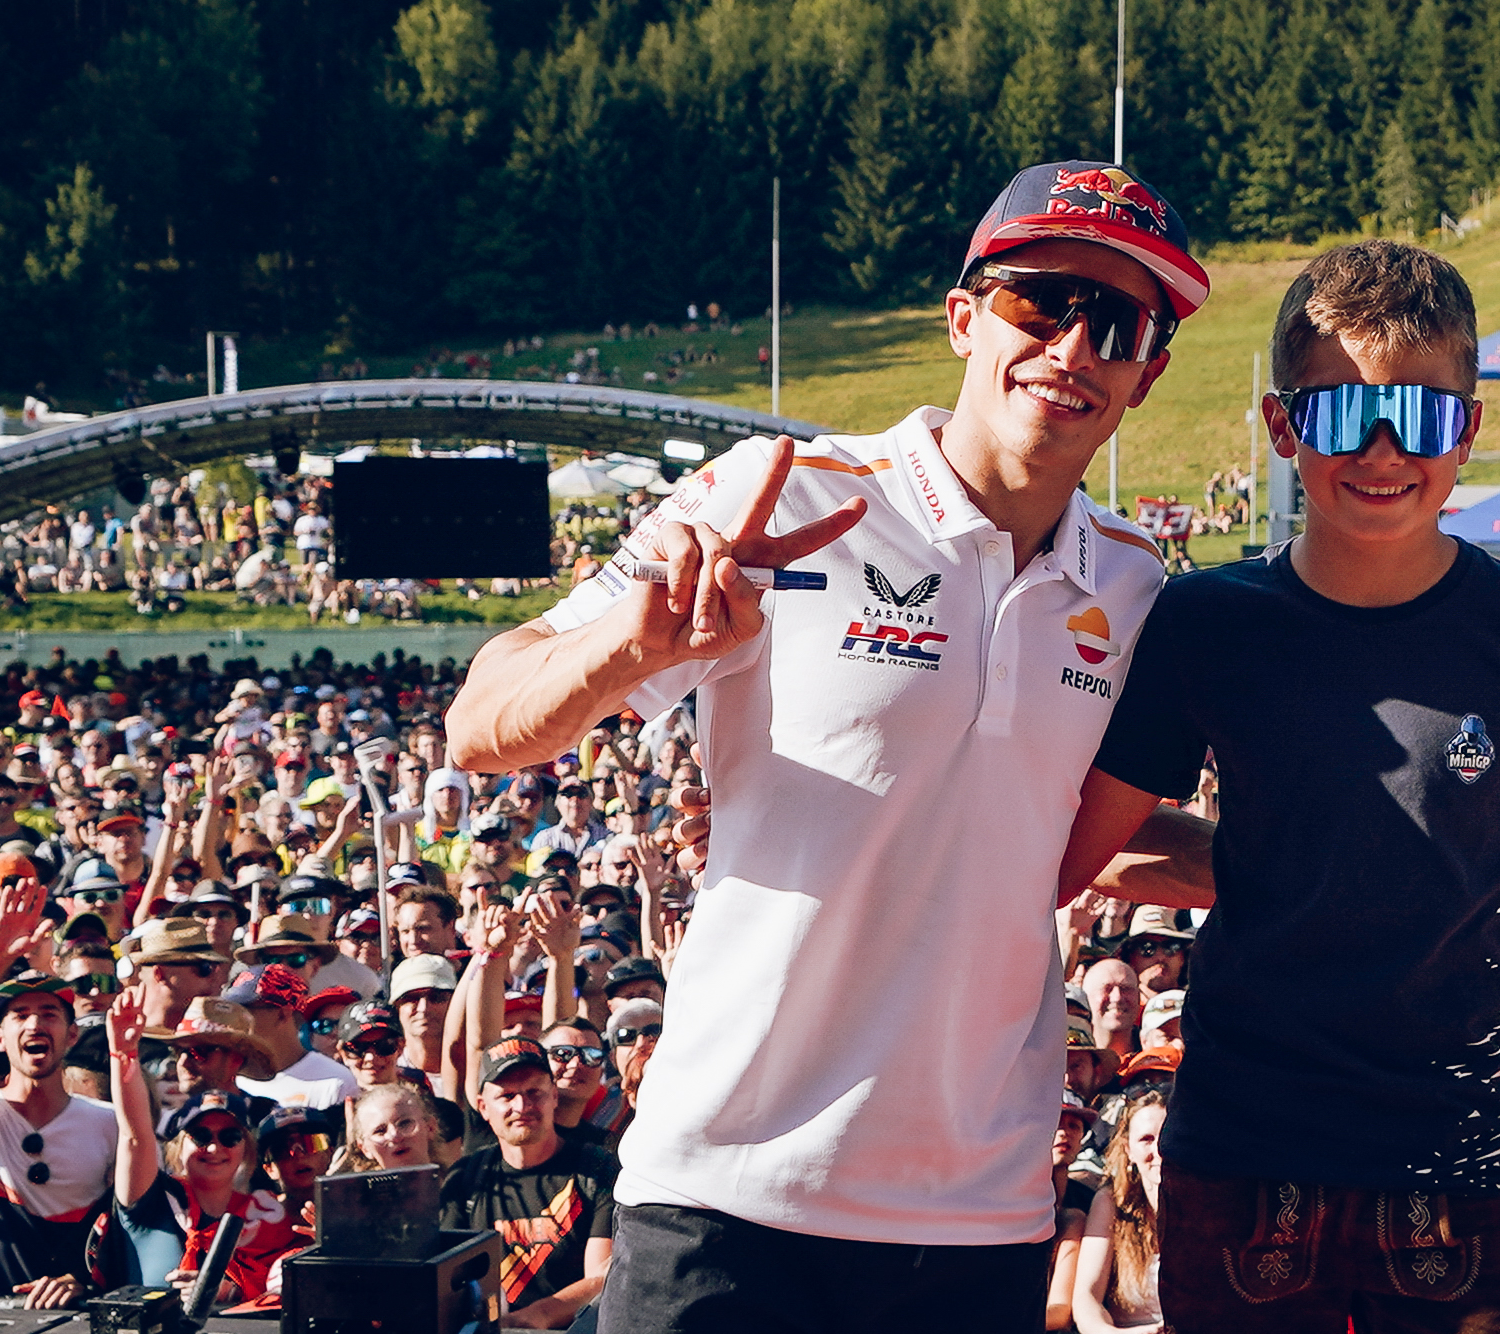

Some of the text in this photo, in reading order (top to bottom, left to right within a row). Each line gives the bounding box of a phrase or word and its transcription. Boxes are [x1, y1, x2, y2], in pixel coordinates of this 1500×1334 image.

[907, 450, 946, 523] HONDA
[671, 488, 703, 518] Bull
[1077, 525, 1088, 580] REPSOL
[863, 606, 936, 627] CASTORE
[840, 621, 949, 663] HRC
[837, 652, 940, 672] Honda RACING
[1060, 666, 1113, 700] REPSOL
[1449, 754, 1491, 769] MiniGP
